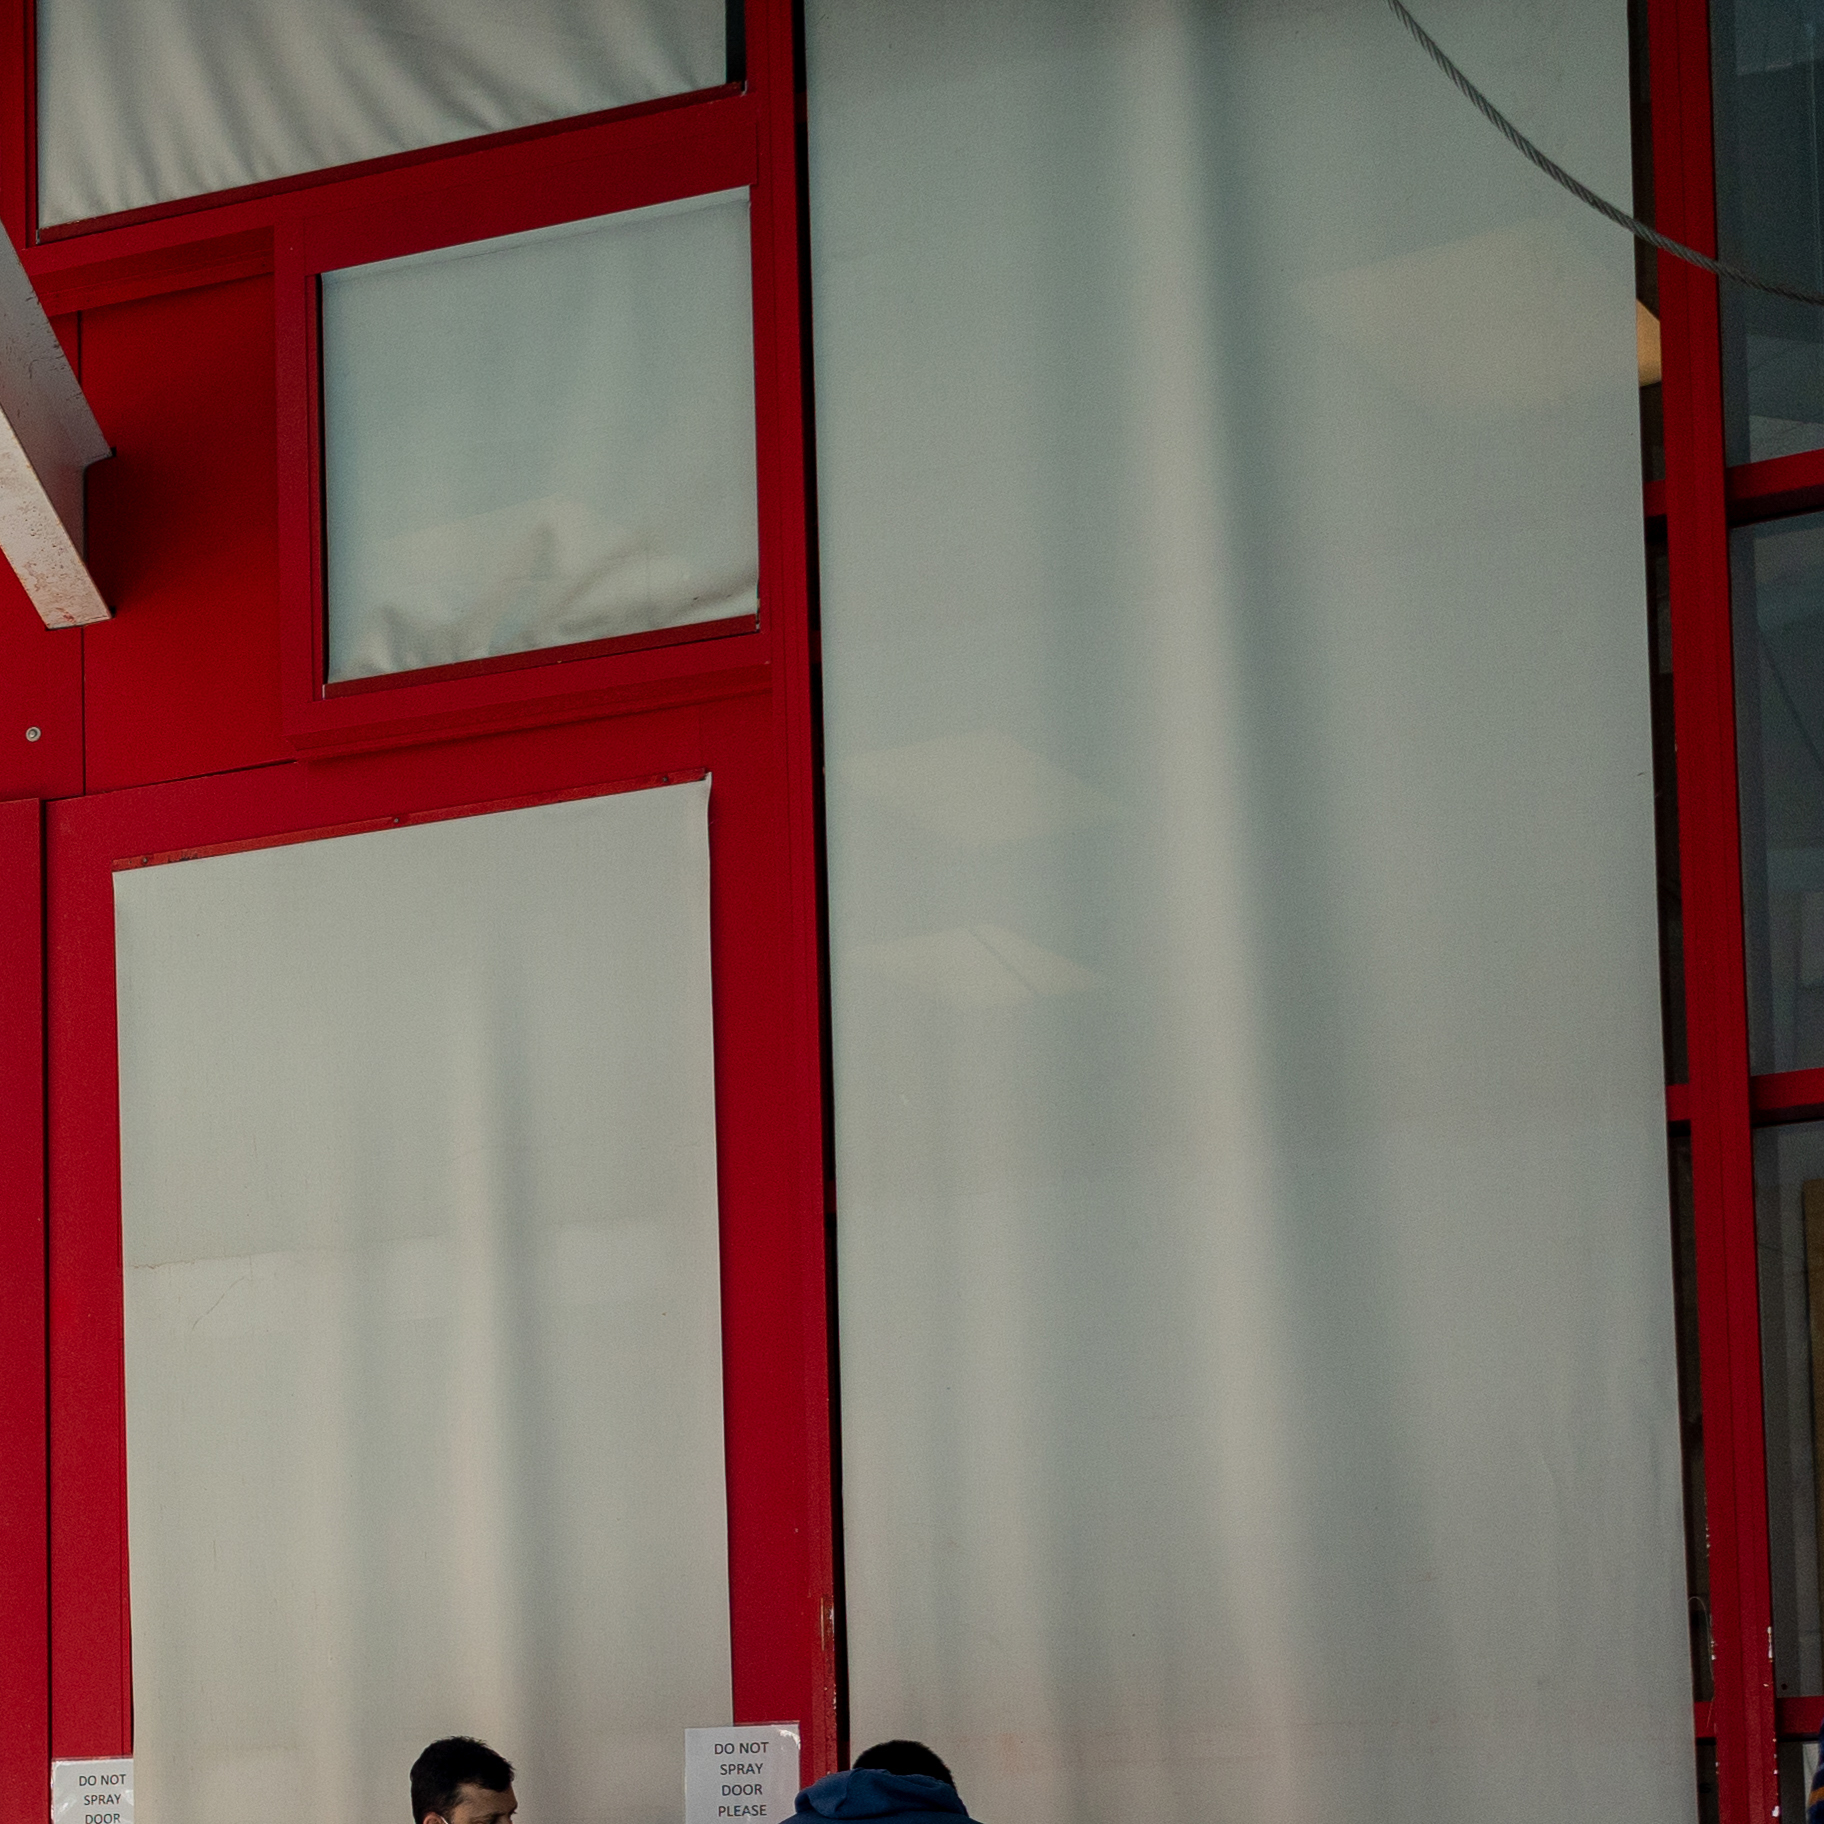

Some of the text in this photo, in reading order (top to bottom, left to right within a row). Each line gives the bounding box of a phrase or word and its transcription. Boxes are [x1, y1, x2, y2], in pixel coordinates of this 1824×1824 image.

[714, 1741, 769, 1755] DO NOT
[720, 1763, 764, 1775] SPRAY
[79, 1773, 127, 1786] DO NOT
[721, 1783, 763, 1796] DOOR
[83, 1793, 121, 1806] SPRAY
[718, 1804, 767, 1817] PLEASE
[85, 1813, 121, 1824] DOOR
